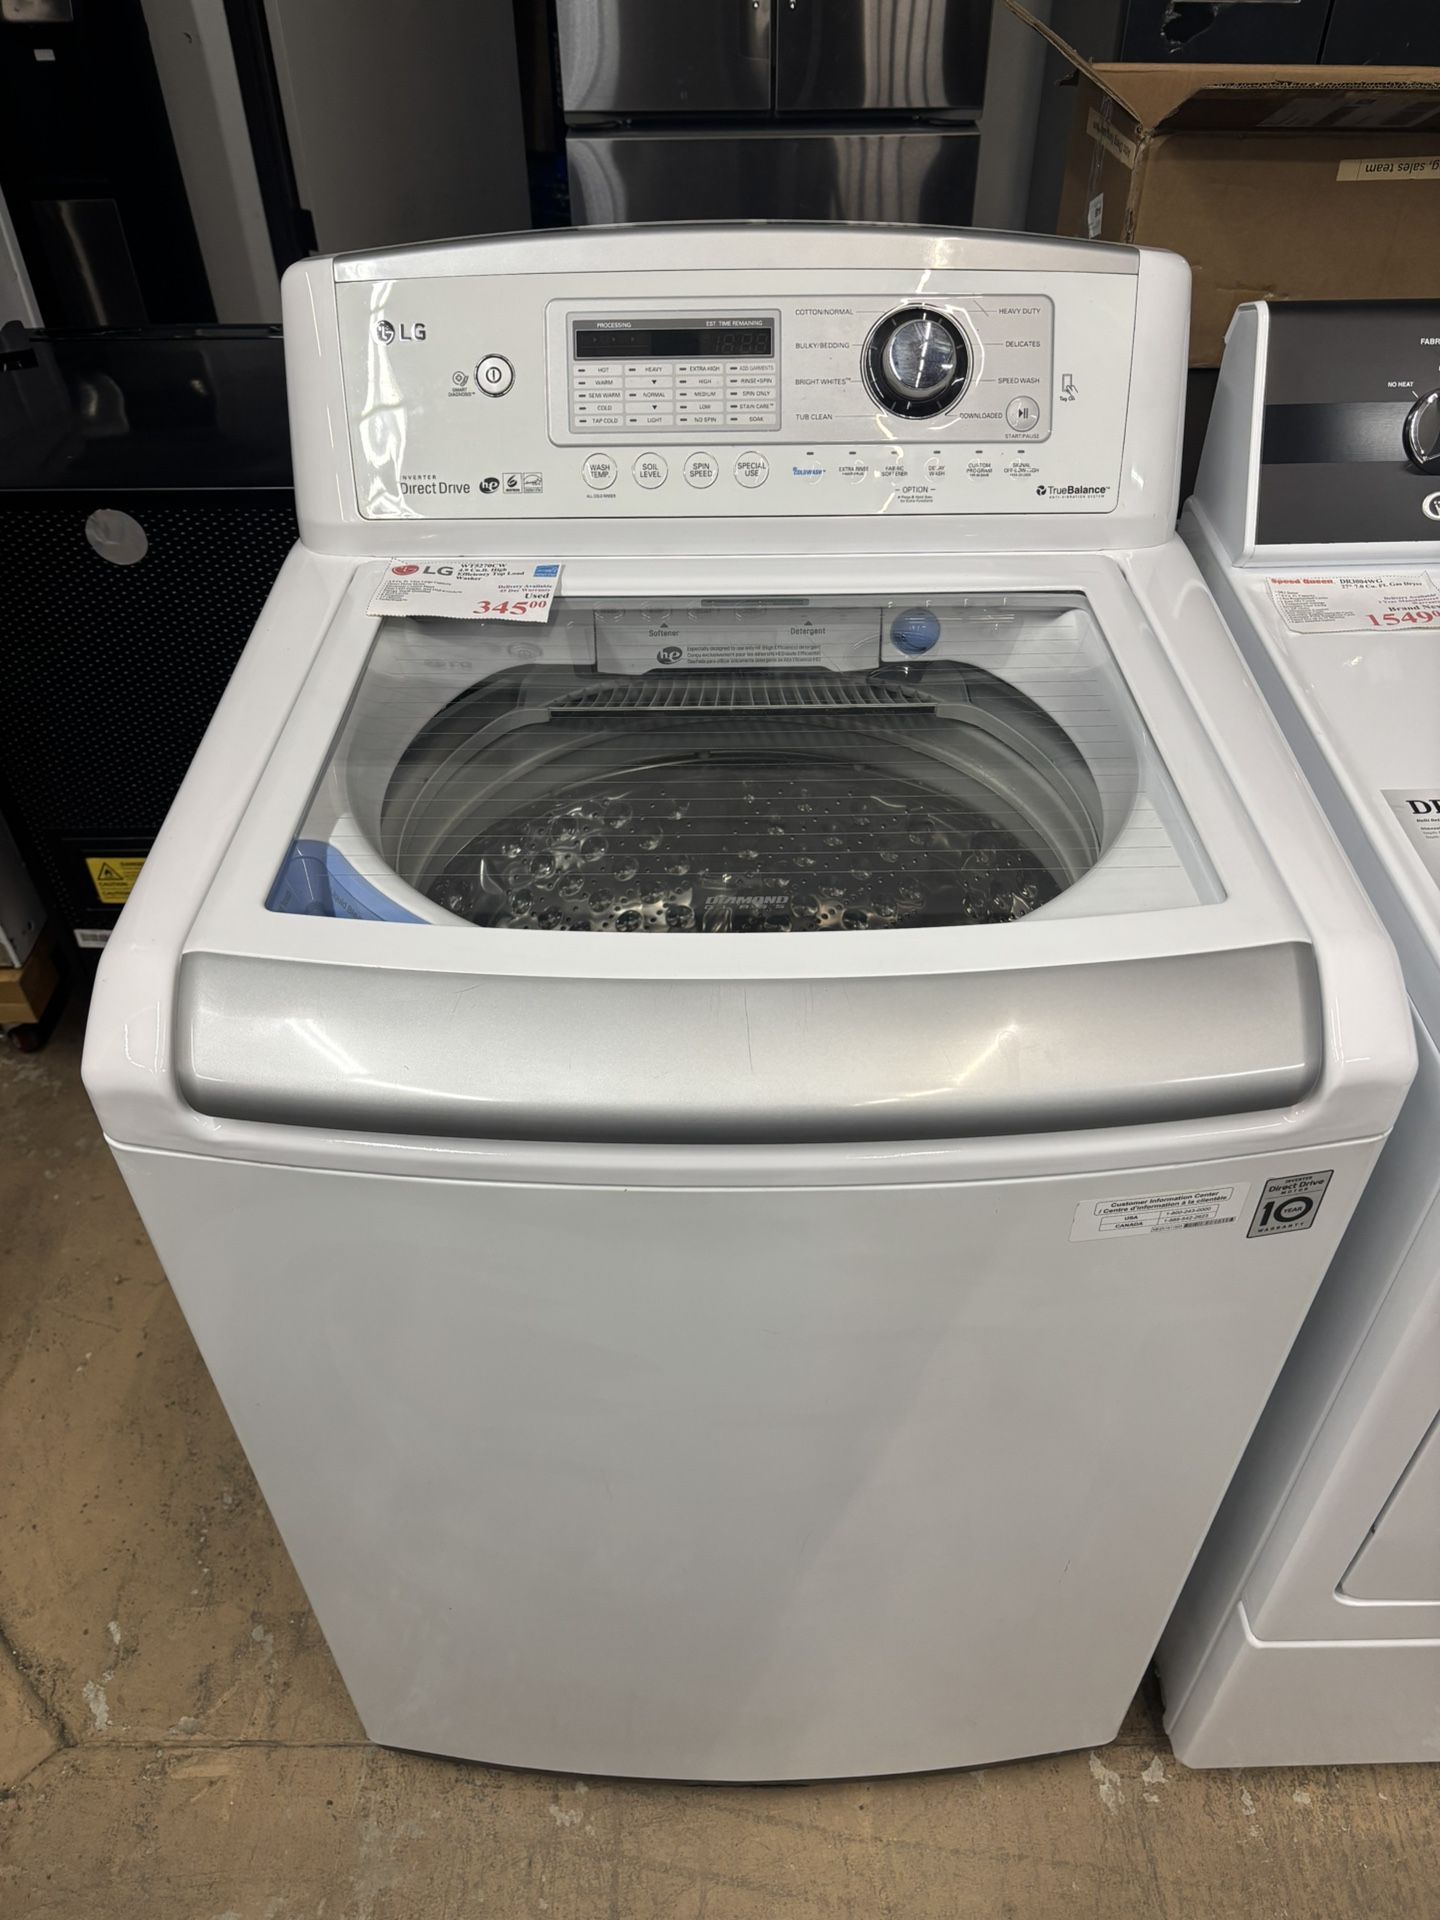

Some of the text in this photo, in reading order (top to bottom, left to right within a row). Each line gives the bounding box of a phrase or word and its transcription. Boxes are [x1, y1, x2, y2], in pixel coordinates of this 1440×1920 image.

[1365, 163, 1394, 173] team
[1397, 162, 1426, 174] sales
[795, 308, 854, 316] COTTON/NORMAL
[399, 322, 427, 341] LG
[795, 378, 820, 386] BRIGHT
[795, 413, 833, 421] TUB CLEAN
[589, 463, 610, 471] WASH
[641, 463, 658, 471] SOIL
[692, 462, 710, 470] SPIN
[737, 462, 767, 470] SPECIAL
[639, 470, 662, 478] LEVEL
[689, 470, 713, 478] SPEED
[744, 469, 760, 477] USE
[400, 481, 471, 495] Direct Drive
[422, 565, 454, 576] LG
[648, 629, 680, 638] Softener
[790, 627, 826, 636] Detergent
[704, 895, 789, 905] DIAMOND
[1268, 1179, 1325, 1193] Direct Drive
[1280, 1187, 1309, 1195] MOTOR
[1110, 1199, 1148, 1208] Customer
[1194, 1191, 1220, 1199] Center
[1103, 1206, 1129, 1214] Centre
[1196, 1195, 1228, 1204] clientèle
[1259, 1196, 1314, 1227] 10
[1283, 1206, 1303, 1214] YEAR
[1114, 1221, 1143, 1229] CANADA
[1257, 1222, 1305, 1233] WARRANTY
